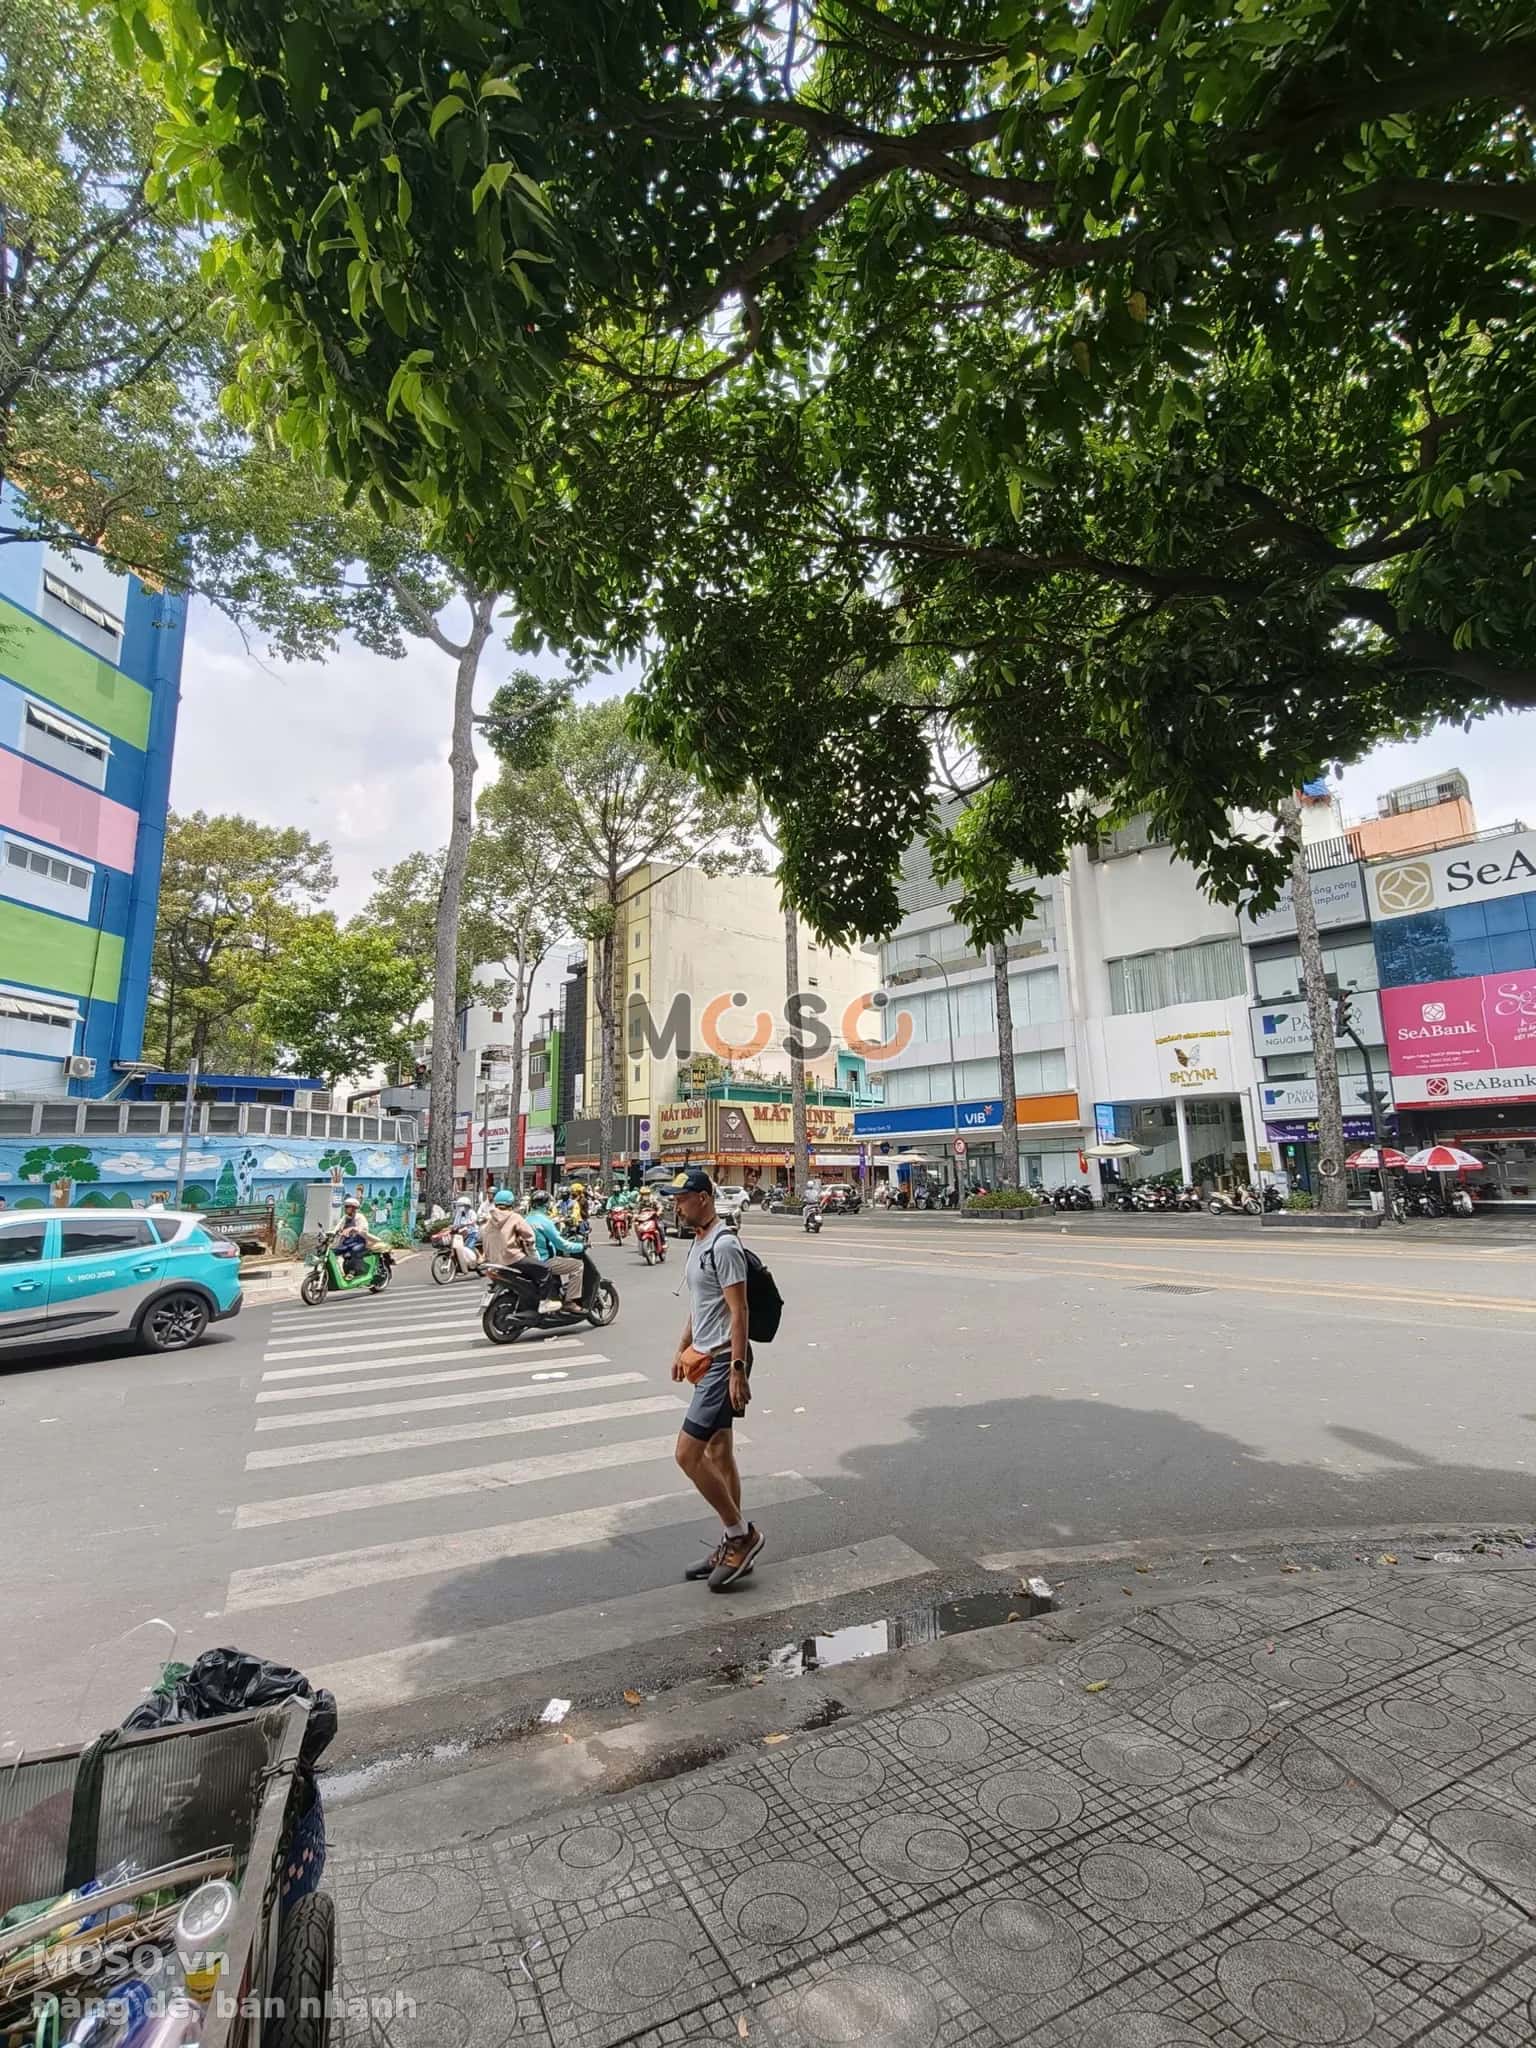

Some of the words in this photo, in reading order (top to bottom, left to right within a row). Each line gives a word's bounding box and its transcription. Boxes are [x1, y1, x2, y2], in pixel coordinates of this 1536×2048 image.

[1397, 1021, 1477, 1040] SeABank
[1453, 1074, 1536, 1091] SeABank
[964, 1112, 986, 1125] VIB
